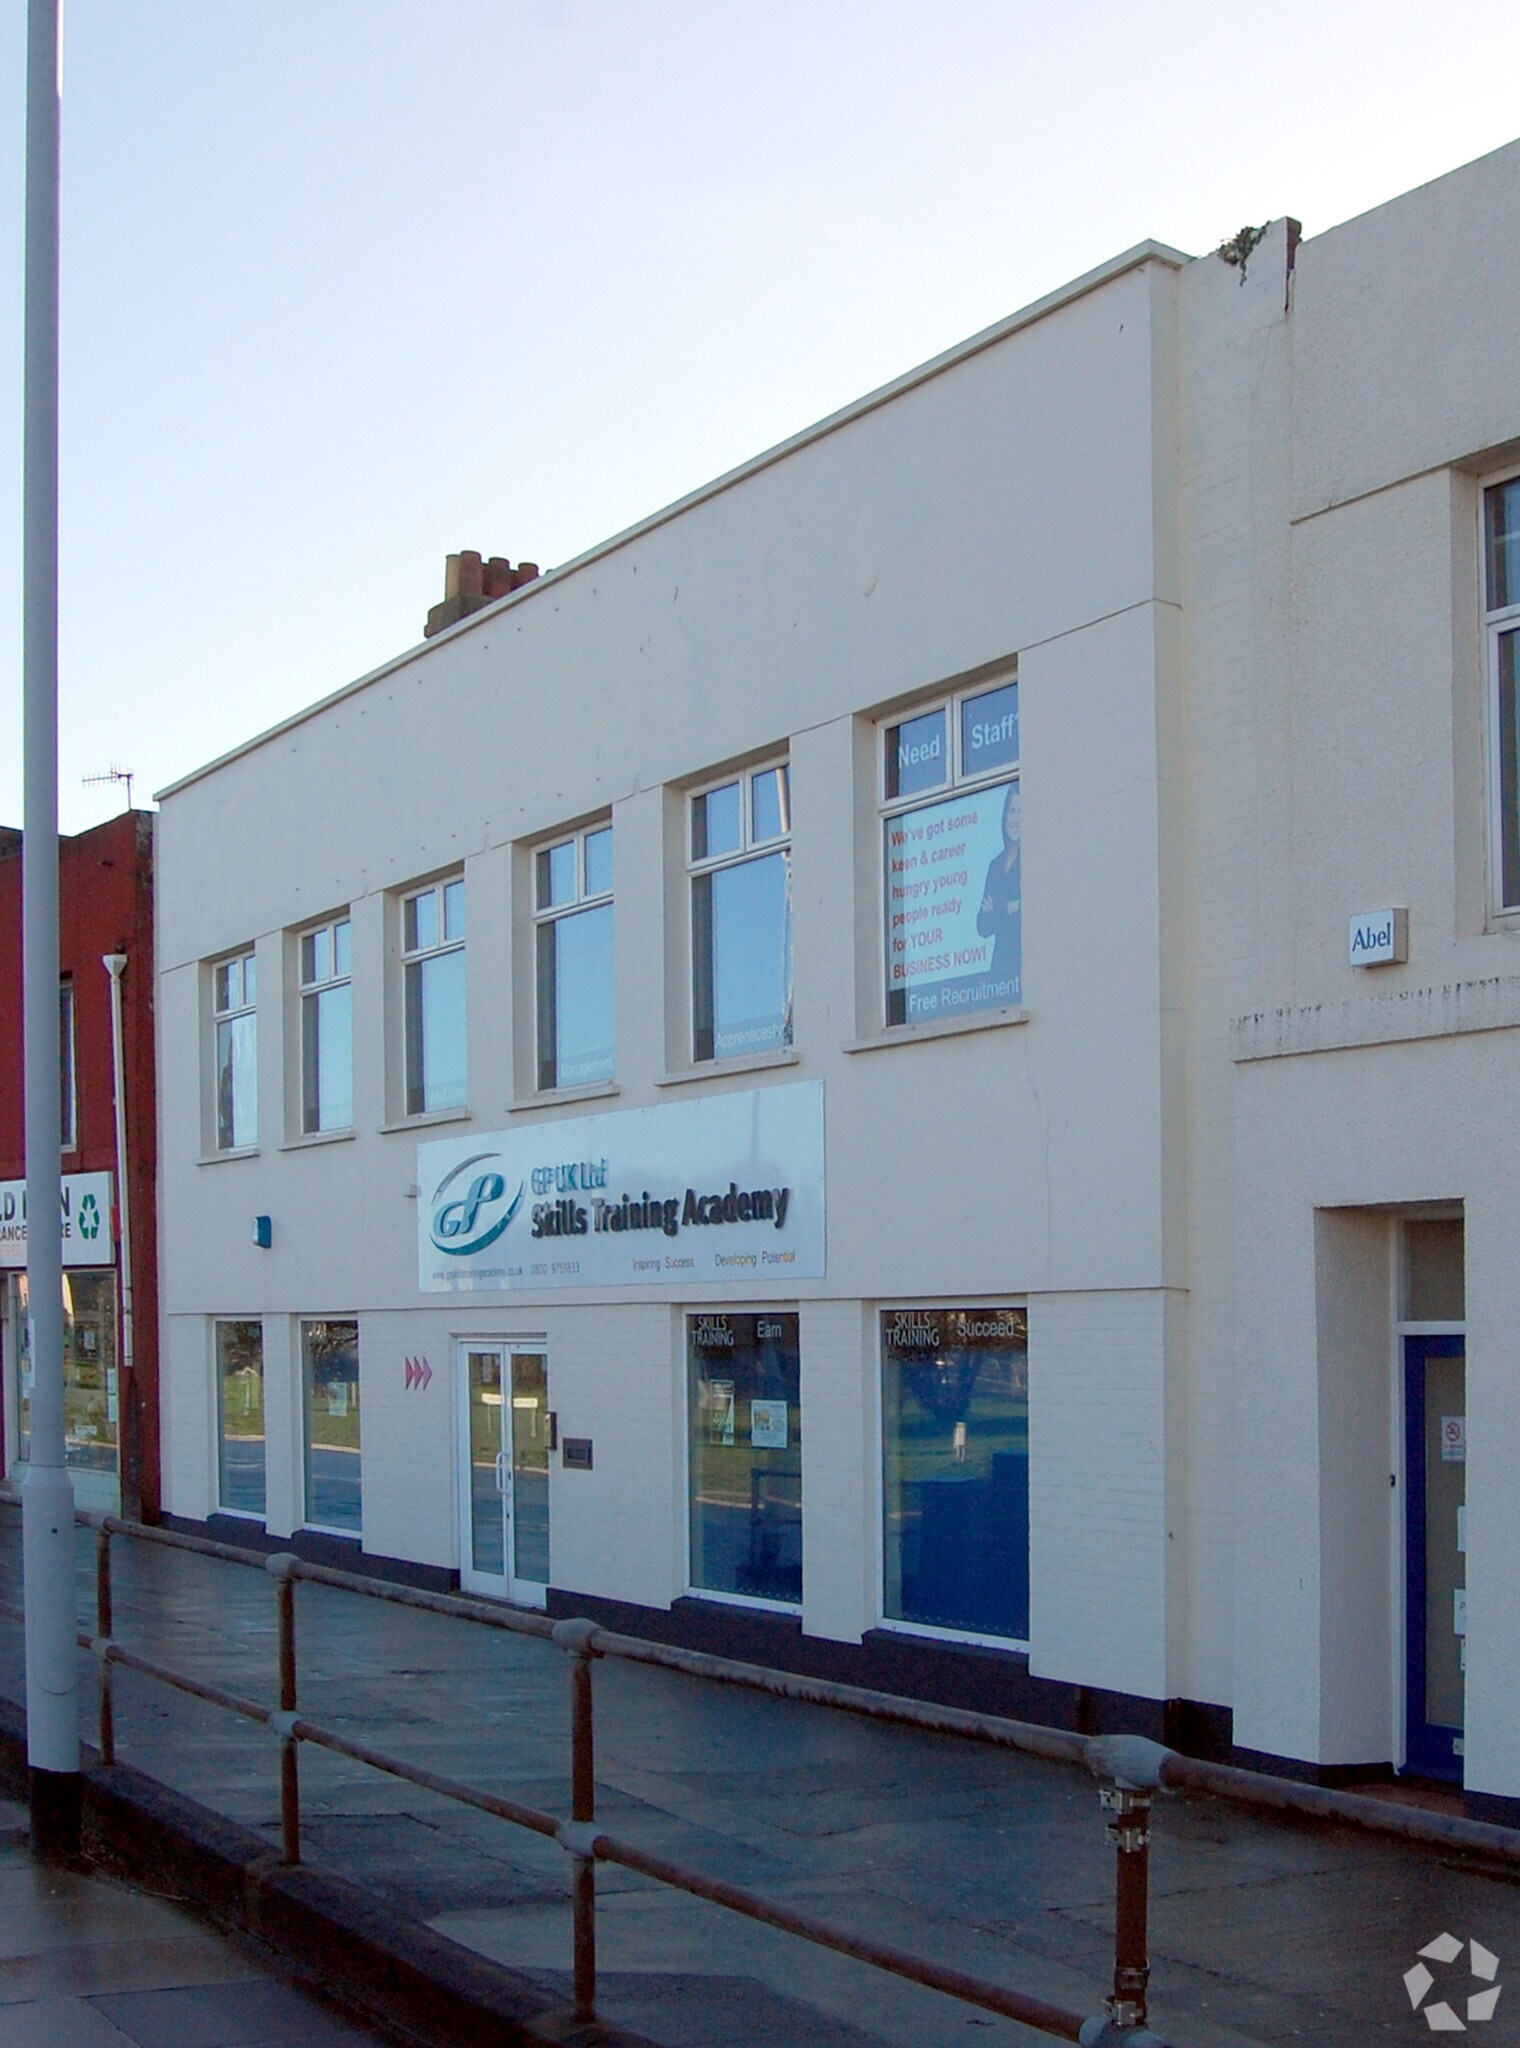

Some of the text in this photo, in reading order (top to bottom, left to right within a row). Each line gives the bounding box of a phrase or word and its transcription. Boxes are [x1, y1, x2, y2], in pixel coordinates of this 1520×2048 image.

[898, 711, 1019, 769] Need Staff
[891, 811, 978, 846] We've got some
[892, 843, 966, 873] keen & career
[892, 870, 968, 900] hungry young
[893, 896, 962, 929] people ready
[893, 927, 943, 952] for YOUR
[1351, 922, 1391, 952] Abel
[893, 945, 986, 979] BUSINESS NOW!
[908, 976, 1020, 1012] Free Recruitment
[531, 1182, 790, 1239] Skills Training Academy
[0, 1225, 27, 1241] ANCE
[632, 1256, 695, 1272] Inspiring Success
[715, 1250, 796, 1268] Developing Potential
[698, 1315, 727, 1331] SKILLS
[894, 1311, 931, 1329] SKILLS
[957, 1317, 1015, 1337] Succeed
[692, 1329, 735, 1346] TRAINING
[886, 1328, 940, 1346] TRAINING
